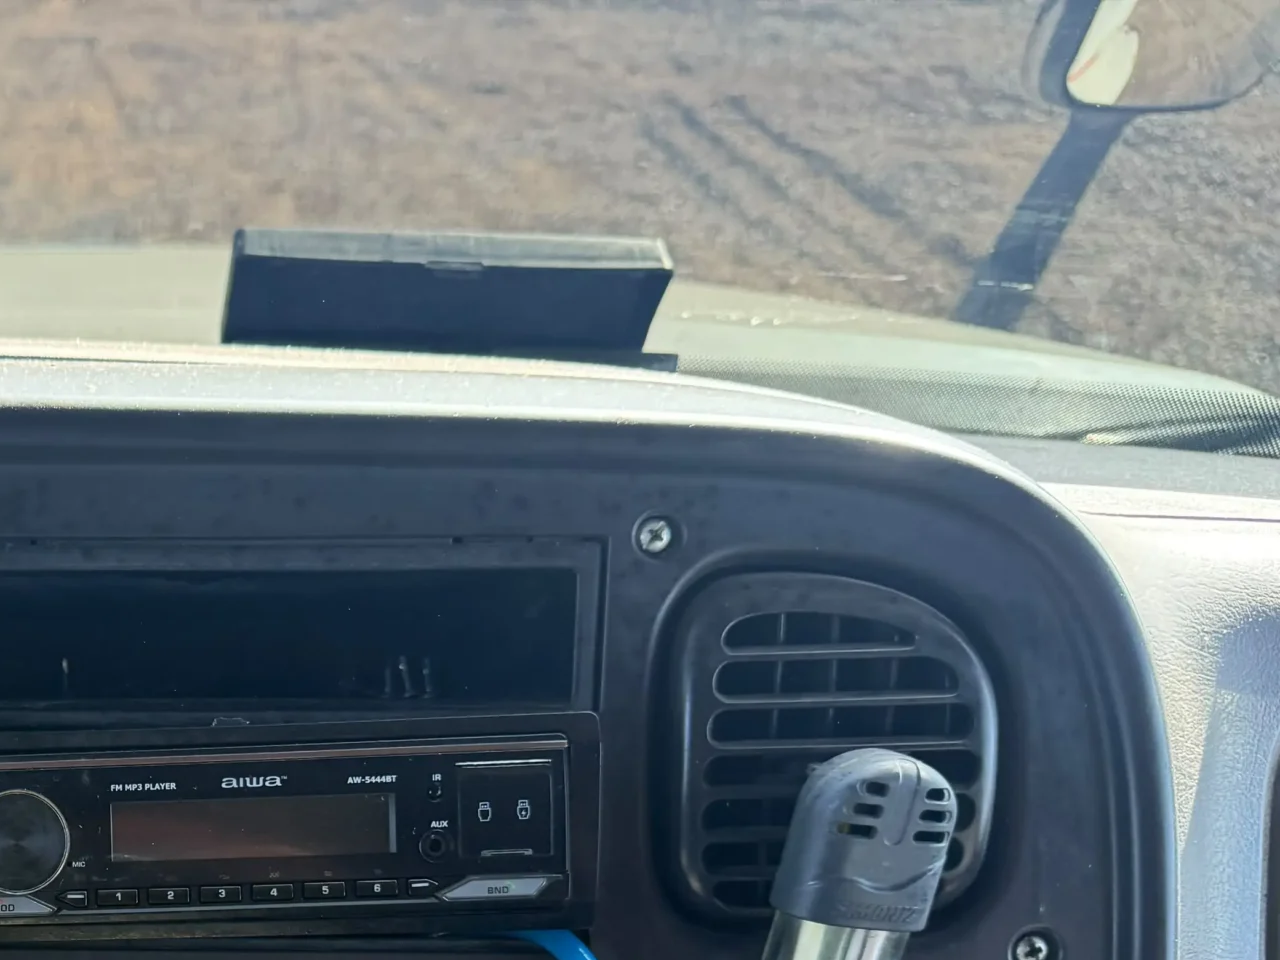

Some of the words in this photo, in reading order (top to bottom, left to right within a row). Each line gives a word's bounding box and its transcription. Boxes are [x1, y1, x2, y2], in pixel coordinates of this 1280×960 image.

[347, 775, 397, 784] AW-5444BT
[110, 784, 123, 792] FM
[125, 783, 143, 791] MP3
[145, 782, 177, 791] PLAYER
[430, 820, 449, 828] AUX
[270, 888, 277, 897] 4
[322, 885, 329, 895] 5
[373, 884, 381, 893] 6
[487, 886, 509, 895] BND
[115, 892, 122, 901] 1
[167, 891, 174, 900] 2
[218, 889, 226, 898] 3
